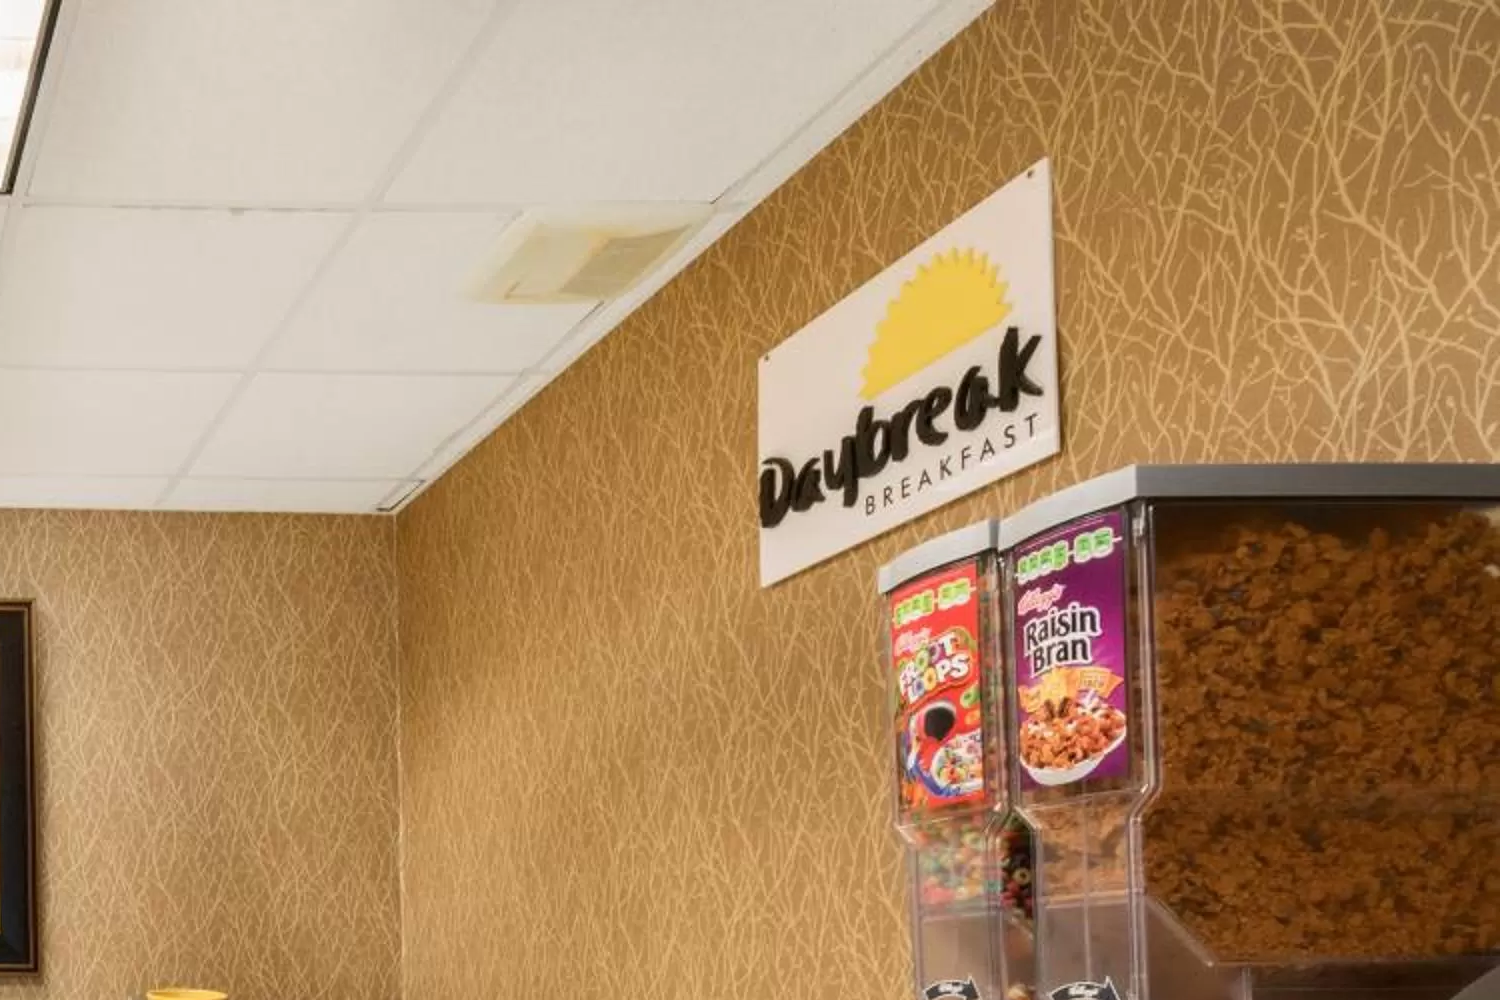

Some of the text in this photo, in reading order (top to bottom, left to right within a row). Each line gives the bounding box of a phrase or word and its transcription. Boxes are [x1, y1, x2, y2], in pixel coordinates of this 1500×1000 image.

[759, 326, 1044, 529] Daybreak
[864, 413, 1040, 516] BREAKFAST
[1025, 604, 1099, 651] Raisin
[1033, 637, 1090, 674] Bran
